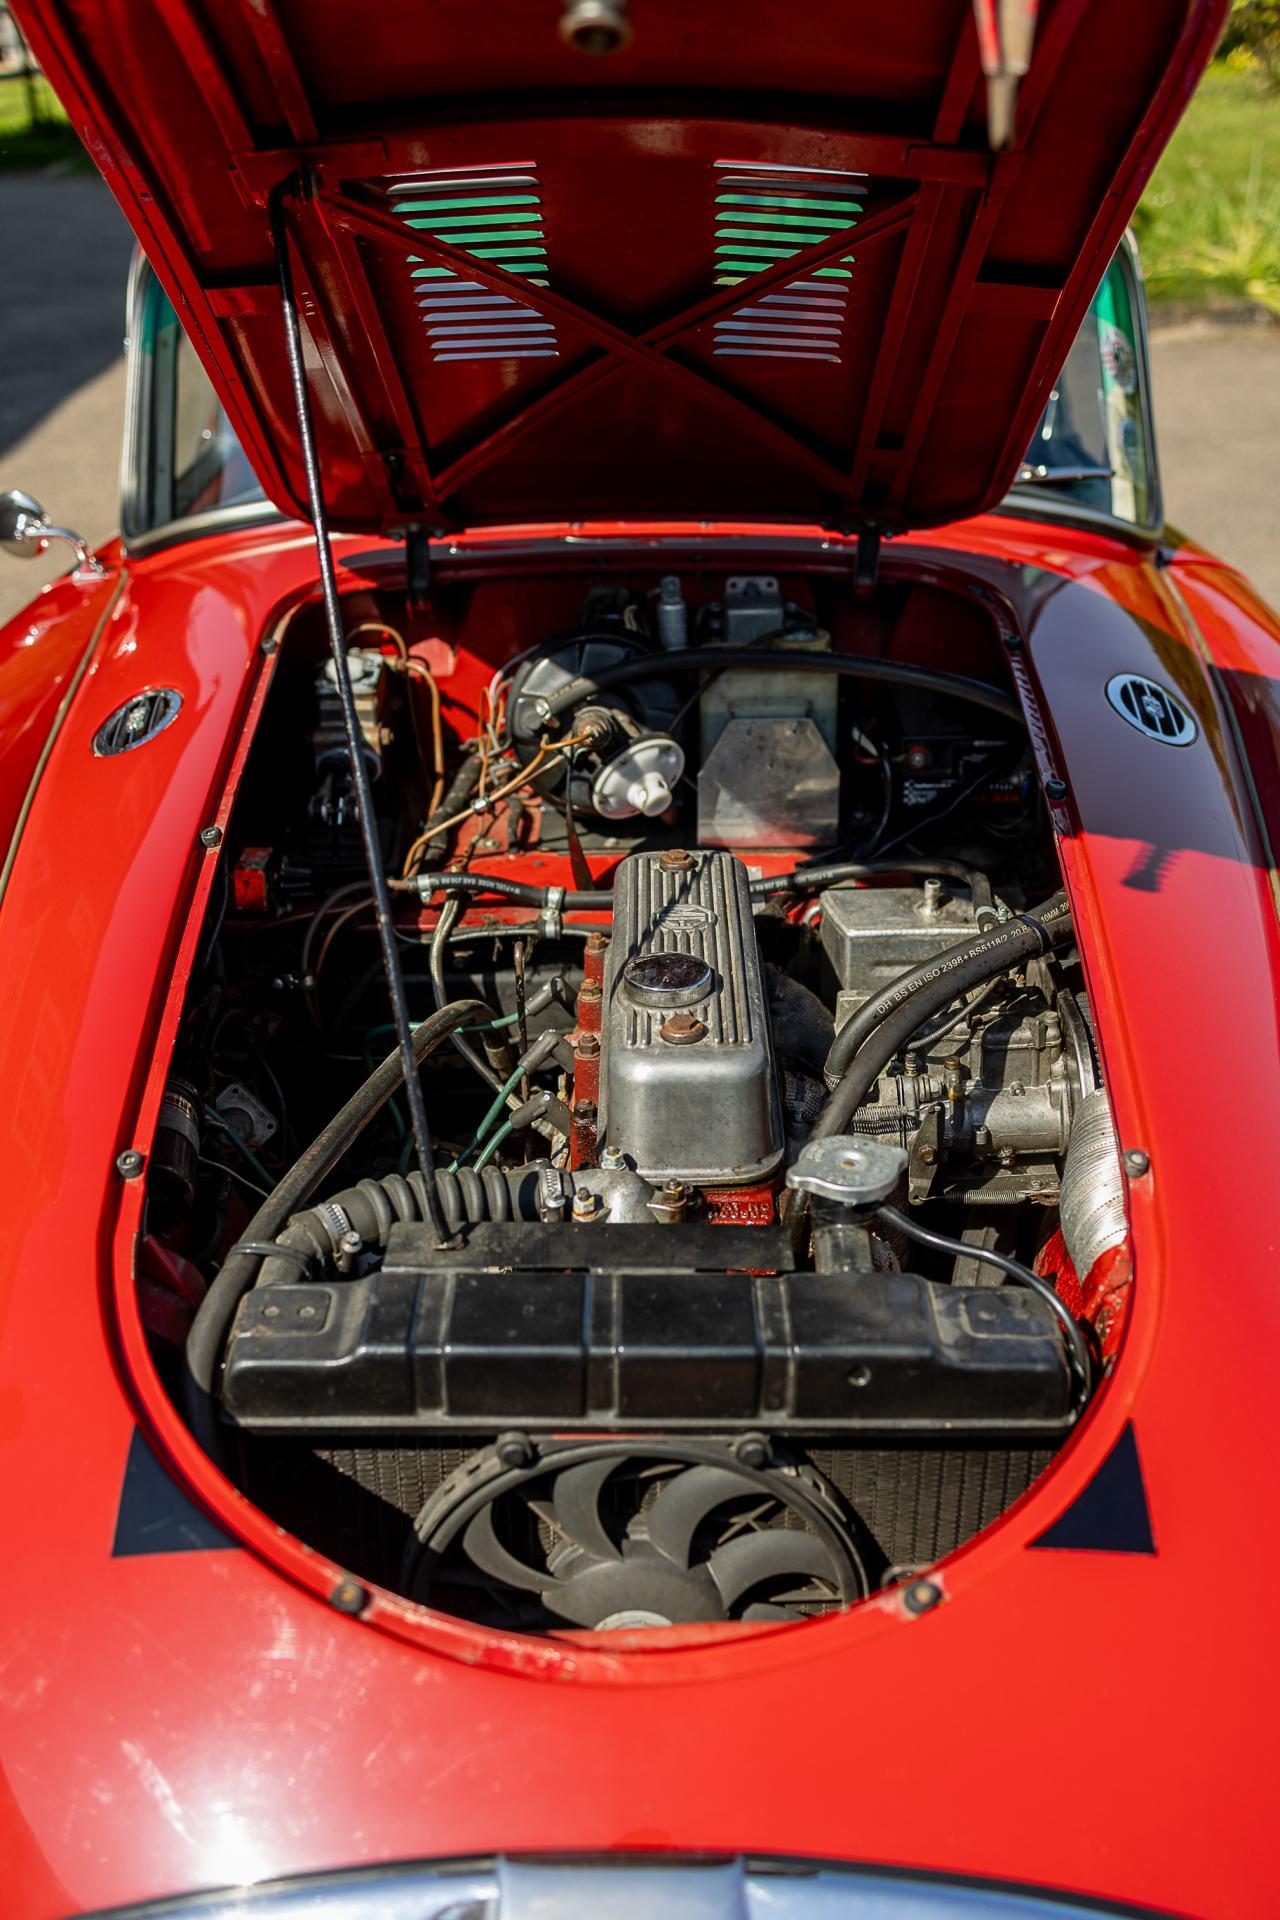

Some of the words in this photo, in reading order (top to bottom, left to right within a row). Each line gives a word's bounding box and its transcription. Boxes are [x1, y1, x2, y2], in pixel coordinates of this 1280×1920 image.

[876, 999, 893, 1014] DH
[893, 988, 908, 1001] BS
[907, 978, 923, 992] EN
[923, 968, 941, 983] ISO
